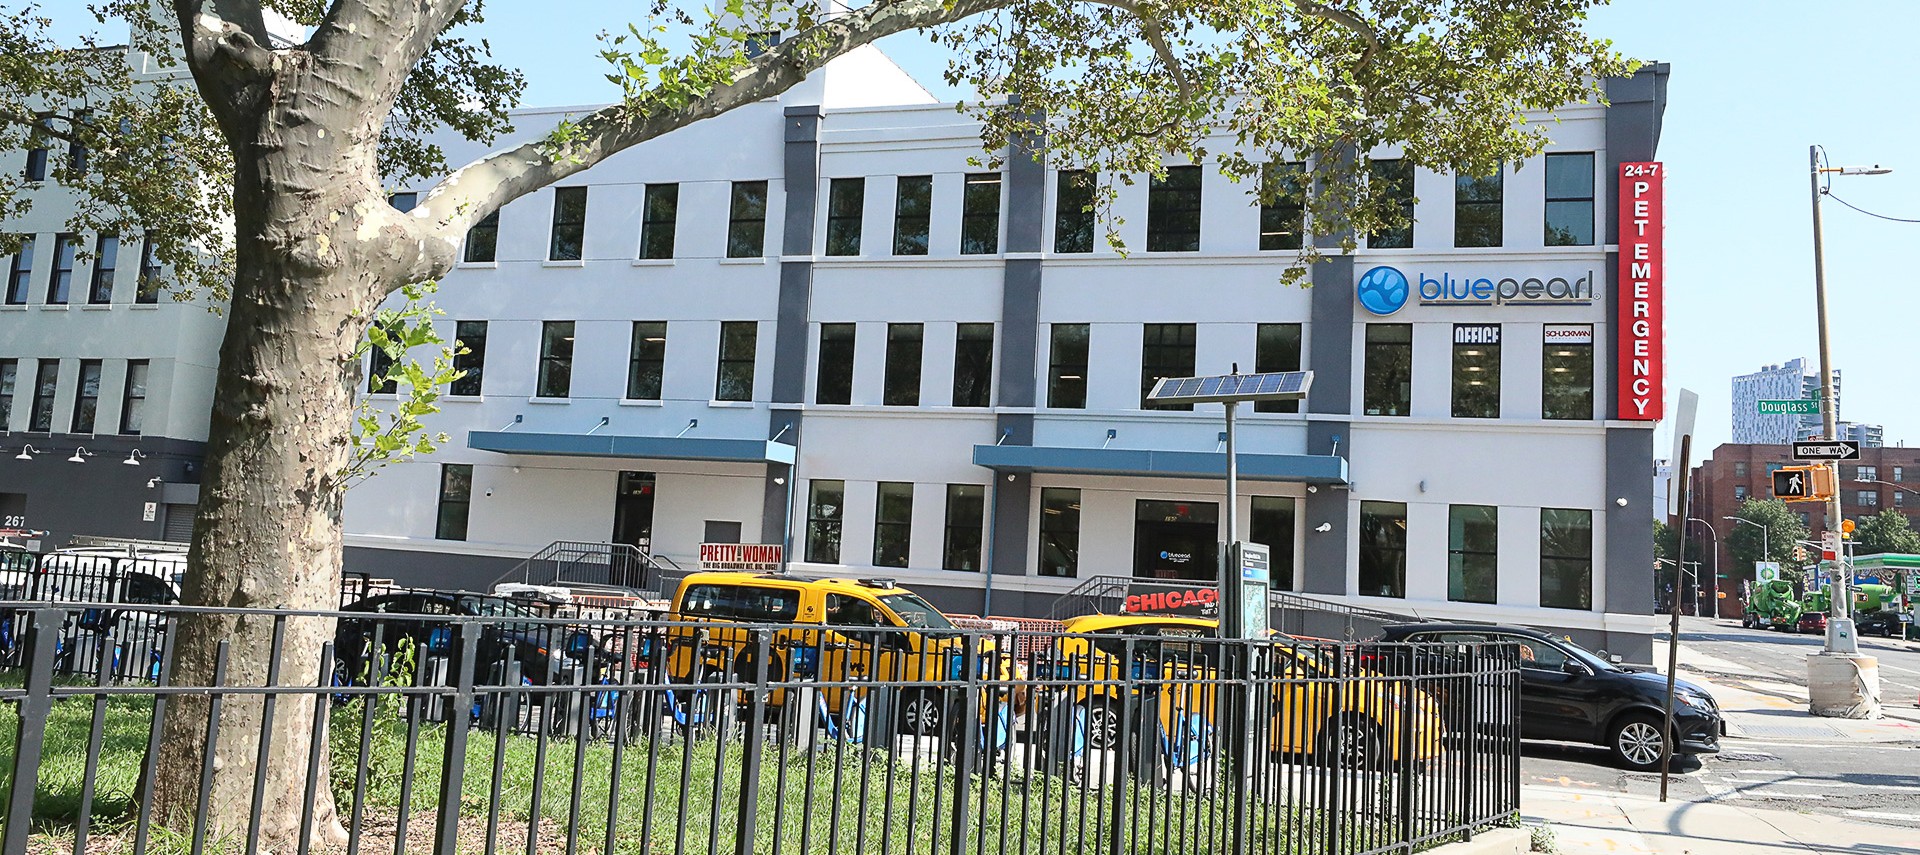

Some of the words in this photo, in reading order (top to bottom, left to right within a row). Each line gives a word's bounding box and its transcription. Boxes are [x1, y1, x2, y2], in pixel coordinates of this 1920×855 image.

[1625, 165, 1658, 177] 24-7
[1634, 181, 1649, 236] PET
[1419, 270, 1593, 305] bluepearl
[1632, 243, 1650, 415] EMERGENCY
[1761, 402, 1808, 414] Douglass
[5, 515, 25, 527] 267
[700, 545, 737, 561] PRETTY
[743, 545, 782, 563] WOMAN
